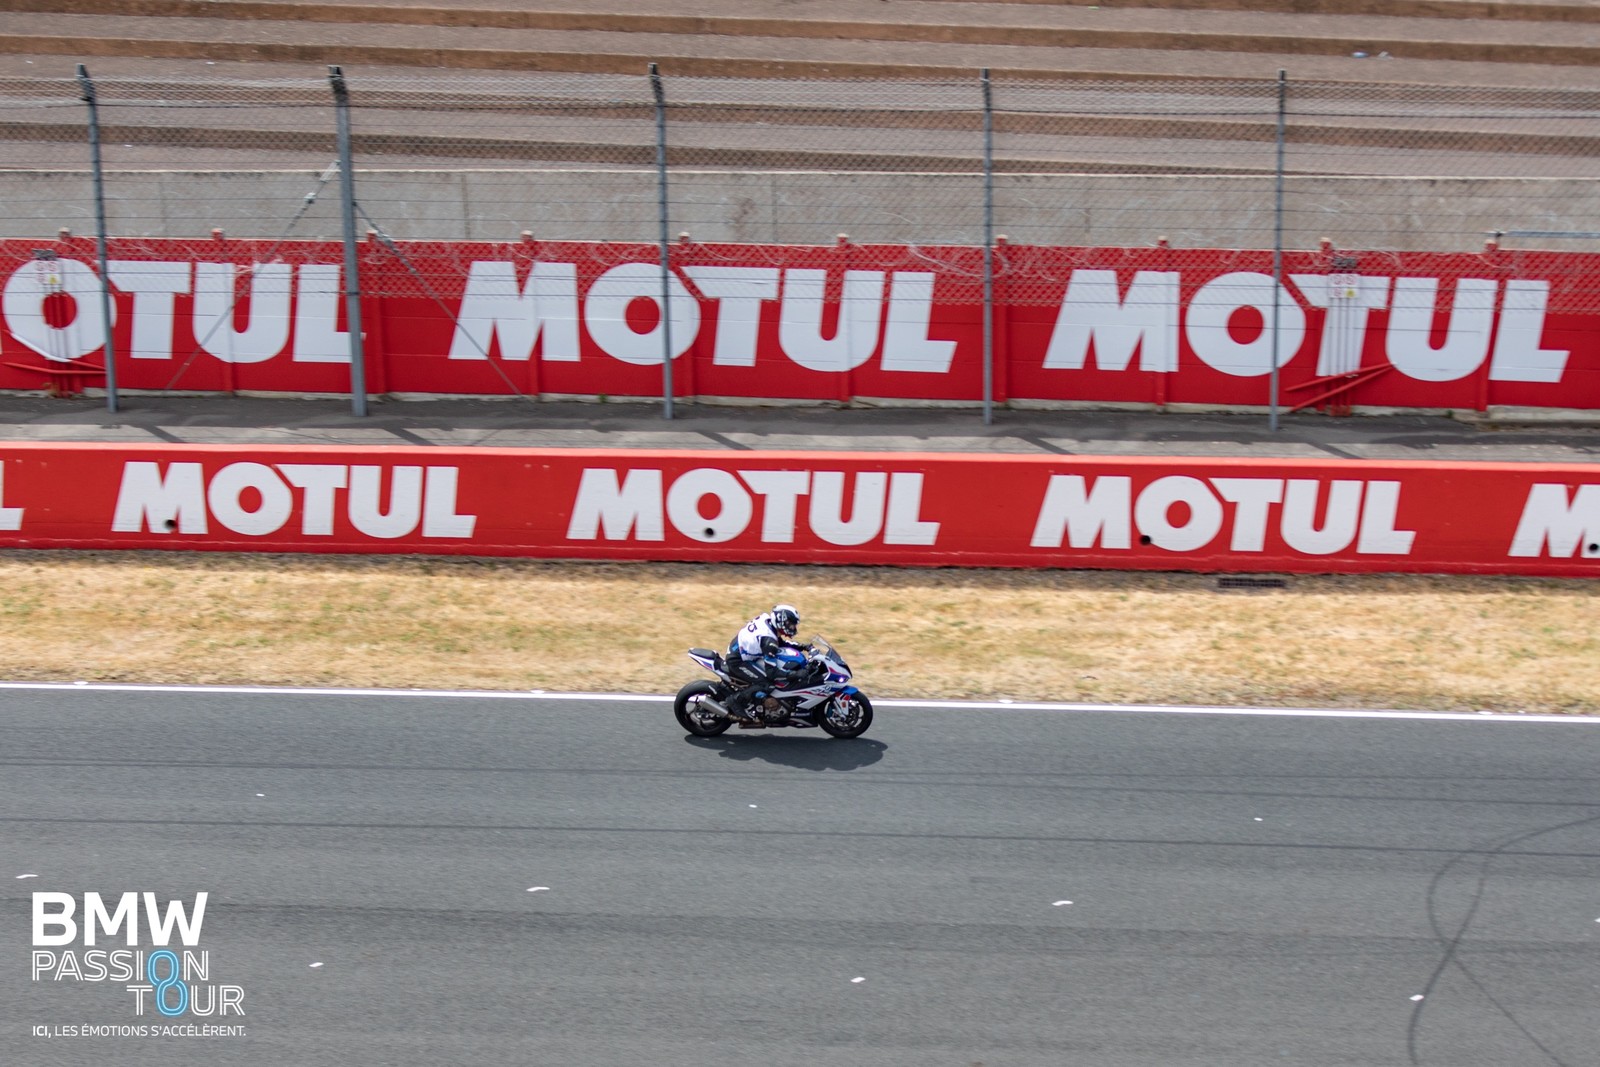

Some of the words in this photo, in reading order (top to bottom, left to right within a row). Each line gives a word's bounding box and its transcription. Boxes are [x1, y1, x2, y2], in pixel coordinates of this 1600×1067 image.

[0, 257, 366, 363] OTUL
[448, 260, 958, 374] MOTUL
[1042, 269, 1571, 383] MOTUL
[111, 461, 477, 539] MOTUL
[566, 467, 941, 546] MOTUL
[1030, 475, 1416, 555] MOTUL
